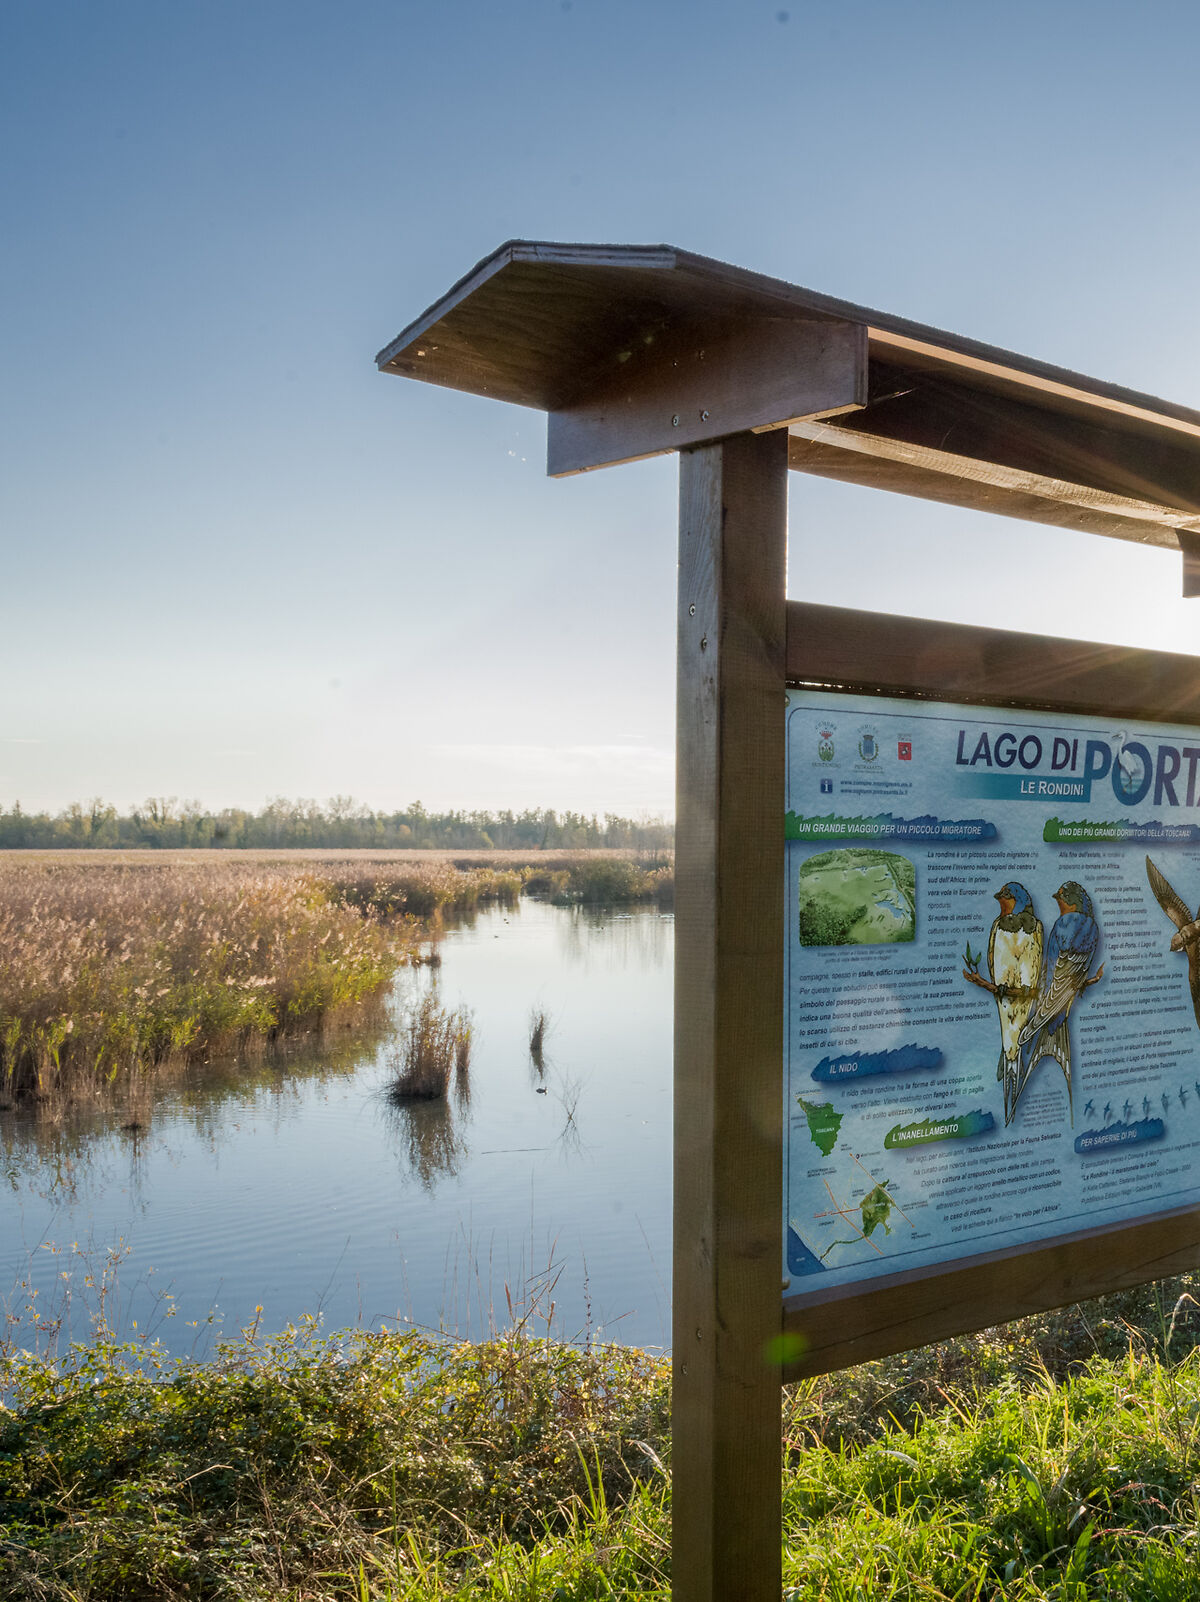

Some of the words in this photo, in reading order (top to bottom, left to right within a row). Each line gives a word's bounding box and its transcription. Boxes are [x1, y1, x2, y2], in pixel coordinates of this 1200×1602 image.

[956, 730, 1043, 770] LAGO
[1051, 737, 1078, 771] DI
[1020, 779, 1035, 795] LE
[1038, 780, 1084, 797] RONDINI
[799, 822, 812, 833] UN
[813, 823, 846, 834] GRANDE
[847, 824, 879, 834] VIAGGIO
[880, 824, 895, 834] PER
[897, 824, 908, 834] UN
[908, 825, 941, 835] PICCOLO
[942, 826, 982, 835] MIGRATORE
[1058, 828, 1072, 836] UNO
[1073, 828, 1082, 837] DEI
[1083, 826, 1094, 837] PIÙ
[1094, 828, 1116, 837] GRANDI
[1116, 828, 1146, 838] DORMITORI
[1148, 829, 1164, 838] DELLA
[968, 852, 988, 860] piccolo
[1006, 852, 1030, 860] migratore
[959, 889, 977, 897] Europa
[800, 1001, 824, 1009] simbolo
[836, 998, 867, 1007] paesaggio
[858, 1022, 884, 1030] sostanze
[912, 1017, 937, 1026] consente
[830, 1064, 837, 1074] IL
[838, 1062, 858, 1073] NIDO
[912, 1081, 929, 1090] forma
[933, 1090, 949, 1099] fango
[924, 1103, 943, 1113] diversi
[892, 1124, 959, 1142] L'INANELLAMENTO
[1080, 1138, 1093, 1148] PER
[1093, 1132, 1121, 1145] SAPERNE
[1121, 1131, 1128, 1141] DI
[1128, 1129, 1138, 1140] PIÙ
[1026, 1136, 1040, 1144] Fauna
[942, 1174, 961, 1183] cattura
[968, 1168, 996, 1179] crepuscolo
